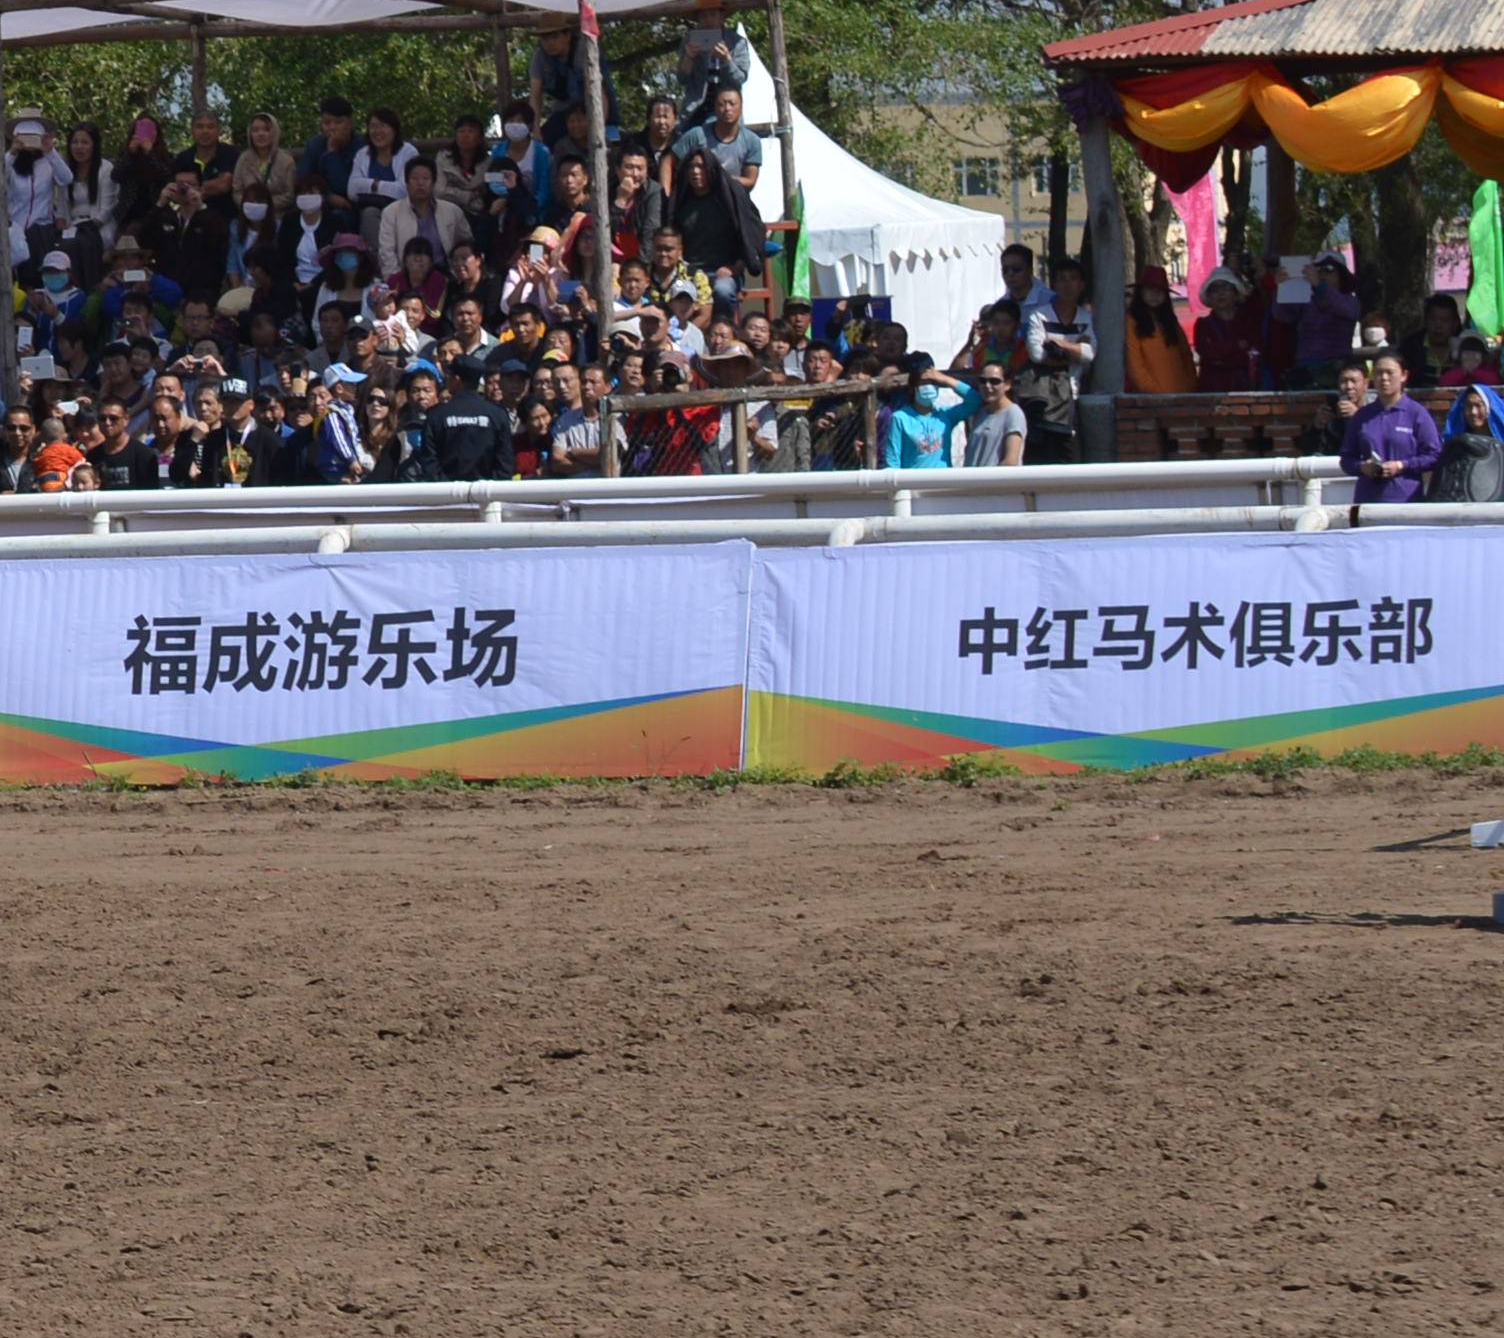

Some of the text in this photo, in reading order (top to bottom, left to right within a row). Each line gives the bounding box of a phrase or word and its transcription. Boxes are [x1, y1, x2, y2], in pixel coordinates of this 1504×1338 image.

[124, 607, 518, 695] 福成游乐场
[958, 596, 1434, 676] 中红马术俱乐部
